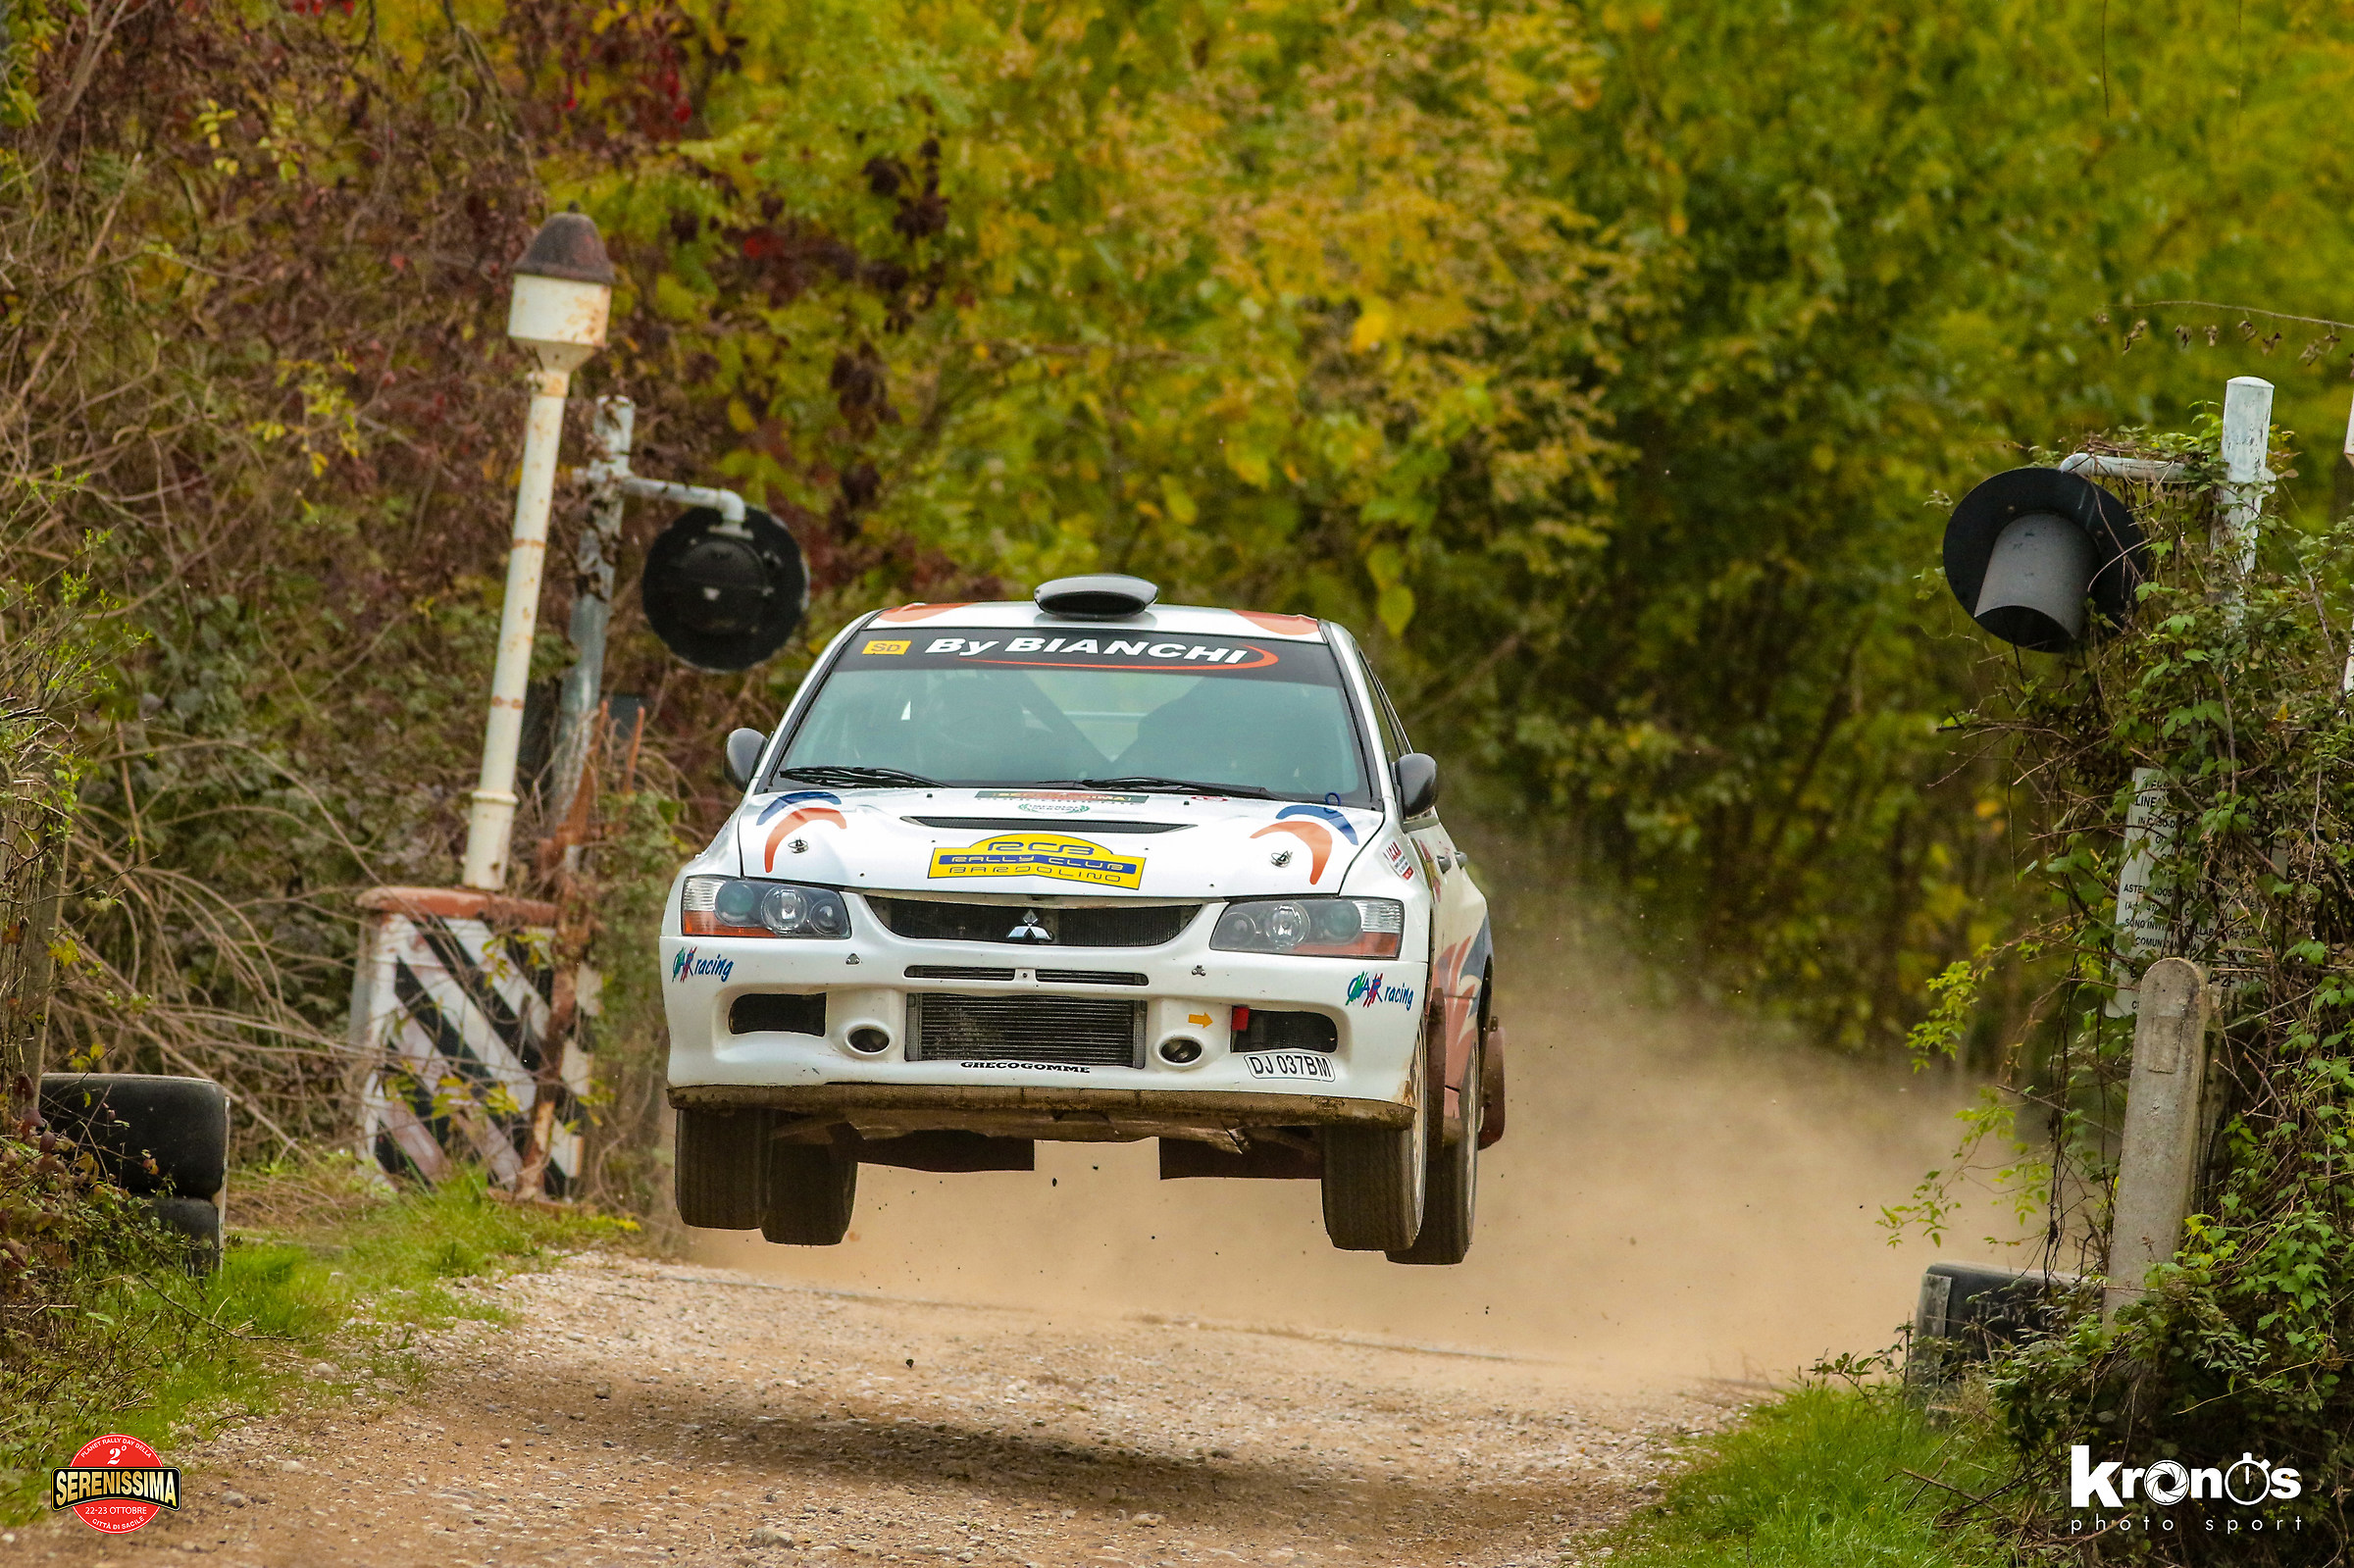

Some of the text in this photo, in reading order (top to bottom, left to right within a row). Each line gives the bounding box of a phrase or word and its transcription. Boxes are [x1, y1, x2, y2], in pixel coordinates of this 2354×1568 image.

[871, 642, 900, 653] SD
[925, 637, 1248, 664] By BIANCHI
[988, 841, 1095, 856] RCB
[1049, 858, 1124, 871] CLUB
[2125, 919, 2146, 929] SONO
[694, 953, 735, 983] racing
[1384, 983, 1414, 1011] racing
[960, 1062, 1091, 1074] GRECOGOMME
[1249, 1055, 1332, 1077] DJ 037BM
